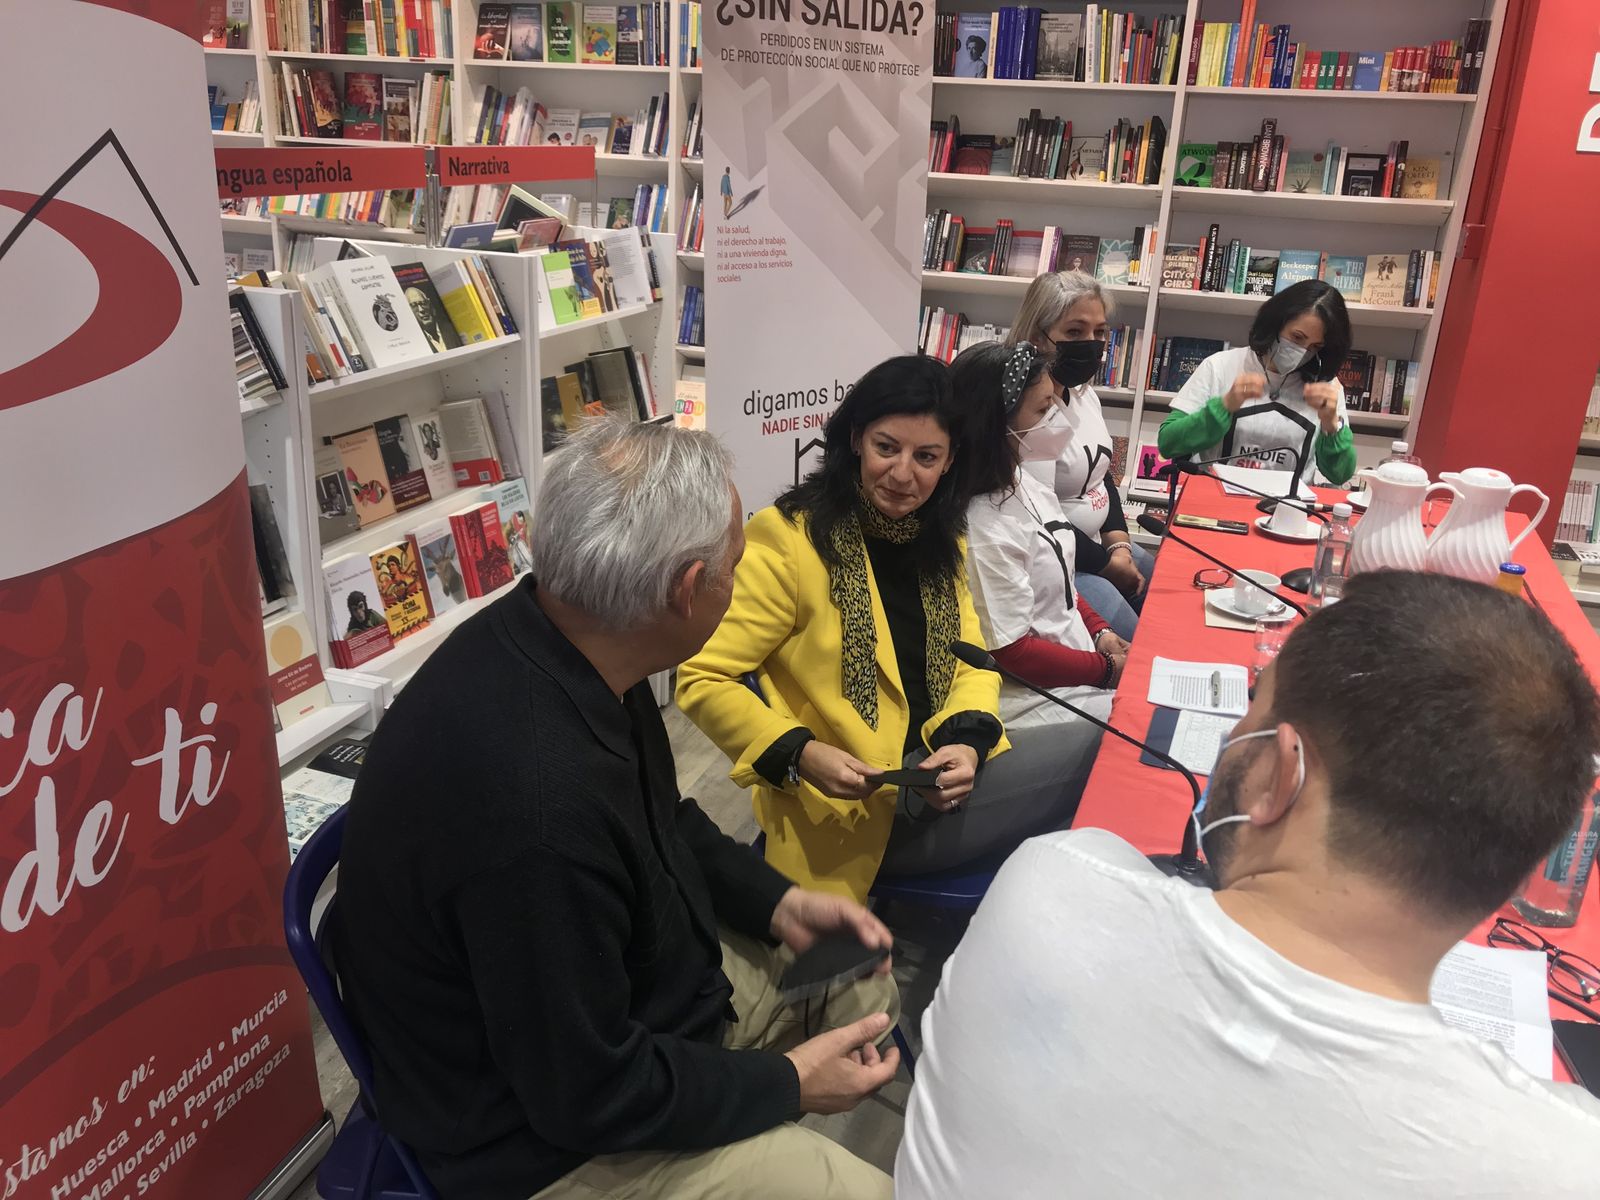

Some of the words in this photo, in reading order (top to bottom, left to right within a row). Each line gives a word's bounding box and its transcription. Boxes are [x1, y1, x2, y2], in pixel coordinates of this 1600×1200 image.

[716, 0, 791, 26] ¿SIN
[801, 0, 924, 36] SALIDA?
[760, 33, 811, 50] PERDIDOS
[813, 37, 828, 51] EN
[829, 39, 842, 52] UN
[845, 41, 885, 56] SISTEMA
[721, 48, 735, 62] DE
[737, 49, 802, 67] PROTECCIÓN
[805, 56, 840, 70] SOCIAL
[842, 60, 861, 72] QUE
[863, 61, 876, 73] NO
[878, 63, 920, 77] PROTEGE
[1359, 57, 1375, 65] Mini
[448, 156, 510, 177] Narrativa
[217, 166, 267, 193] ngua
[273, 160, 352, 192] española
[717, 226, 724, 234] Ni
[731, 225, 750, 234] salud,
[730, 237, 757, 246] derecho
[742, 249, 769, 258] vivienda
[758, 261, 768, 269] los
[769, 260, 793, 269] servicios
[1281, 261, 1318, 271] Beekeeper
[717, 275, 741, 283] sociales
[1163, 270, 1186, 279] CITY
[1281, 271, 1313, 282] Aleppo
[1164, 279, 1193, 288] GIRLS
[1371, 290, 1394, 298] Frank
[1363, 297, 1402, 306] McCourt
[743, 387, 829, 419] digamos
[1345, 394, 1358, 405] EN
[762, 416, 800, 436] NADIE
[803, 414, 823, 430] SIN
[0, 775, 130, 932] de
[131, 702, 231, 825] ti
[51, 1129, 130, 1200] Huesca
[148, 1049, 213, 1119] Madrid
[231, 988, 289, 1045] Murcia
[81, 1128, 167, 1200] Mallorca
[183, 1033, 271, 1120] Pamplona
[137, 1131, 198, 1197] Sevilla
[213, 1044, 291, 1122] Zaragoza
[0, 1096, 108, 1200] stamos
[117, 1055, 155, 1104] en:
